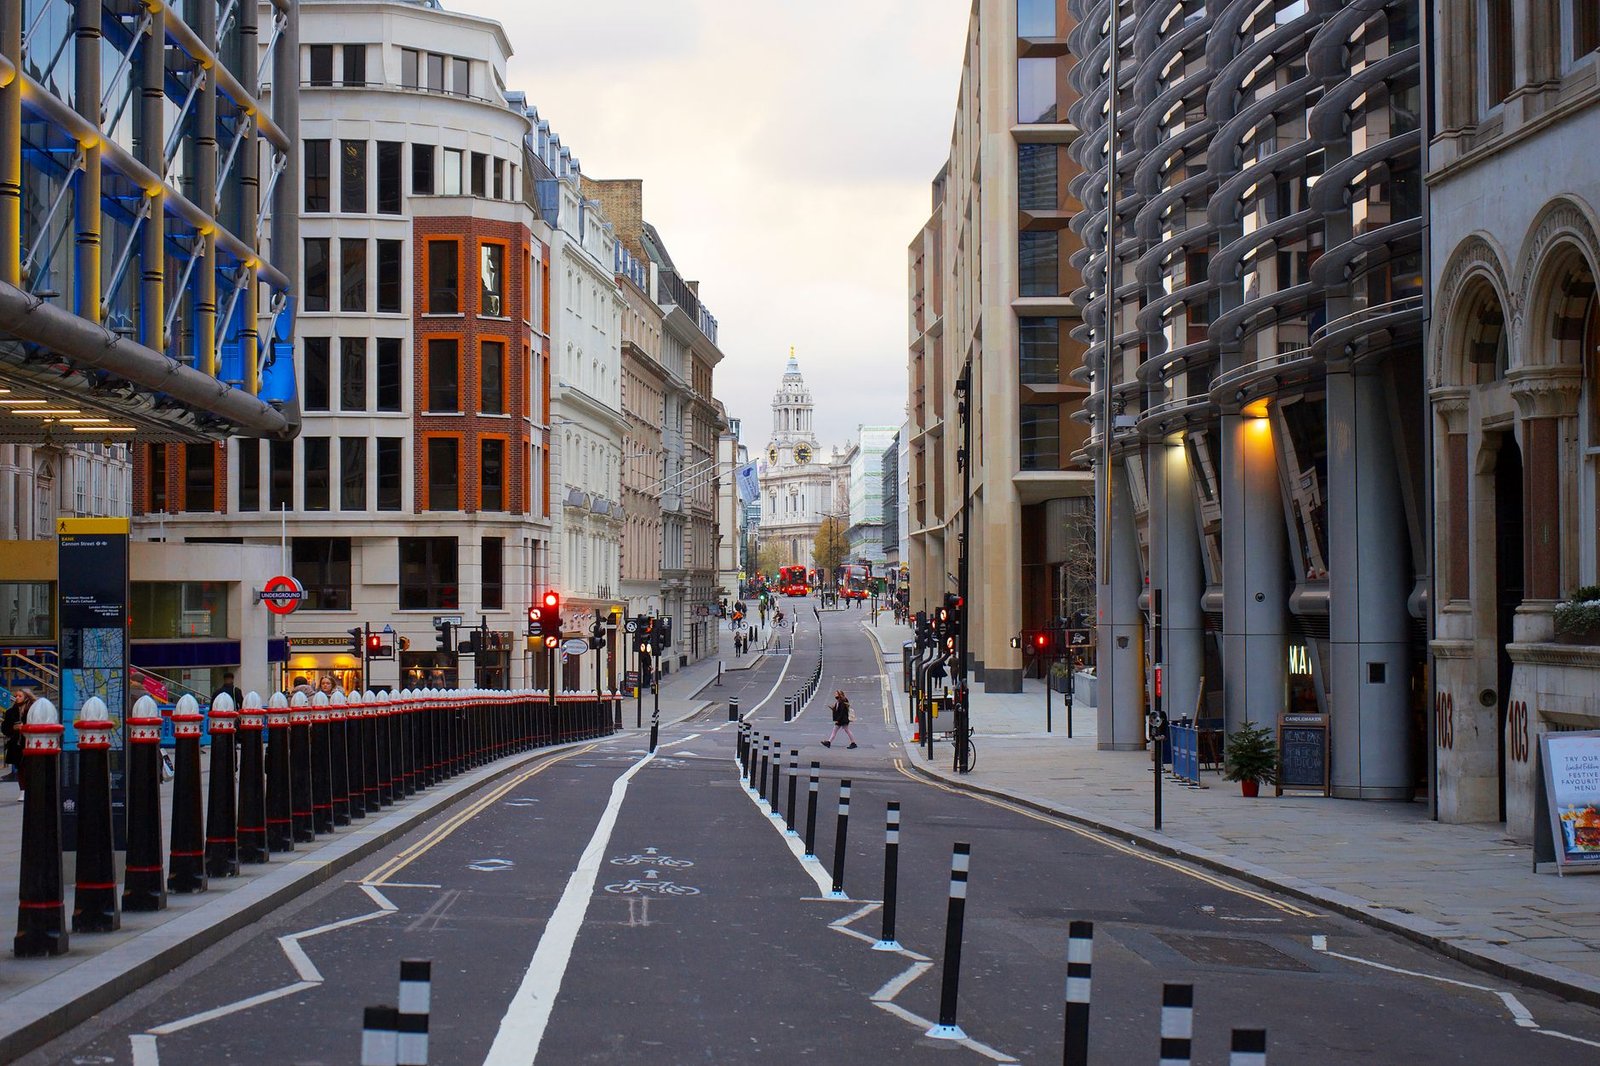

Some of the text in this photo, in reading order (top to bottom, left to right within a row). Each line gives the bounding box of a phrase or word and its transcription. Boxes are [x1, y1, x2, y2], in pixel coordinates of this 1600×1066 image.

[1289, 645, 1312, 675] MA
[1436, 691, 1453, 750] 103
[1508, 700, 1529, 763] 103
